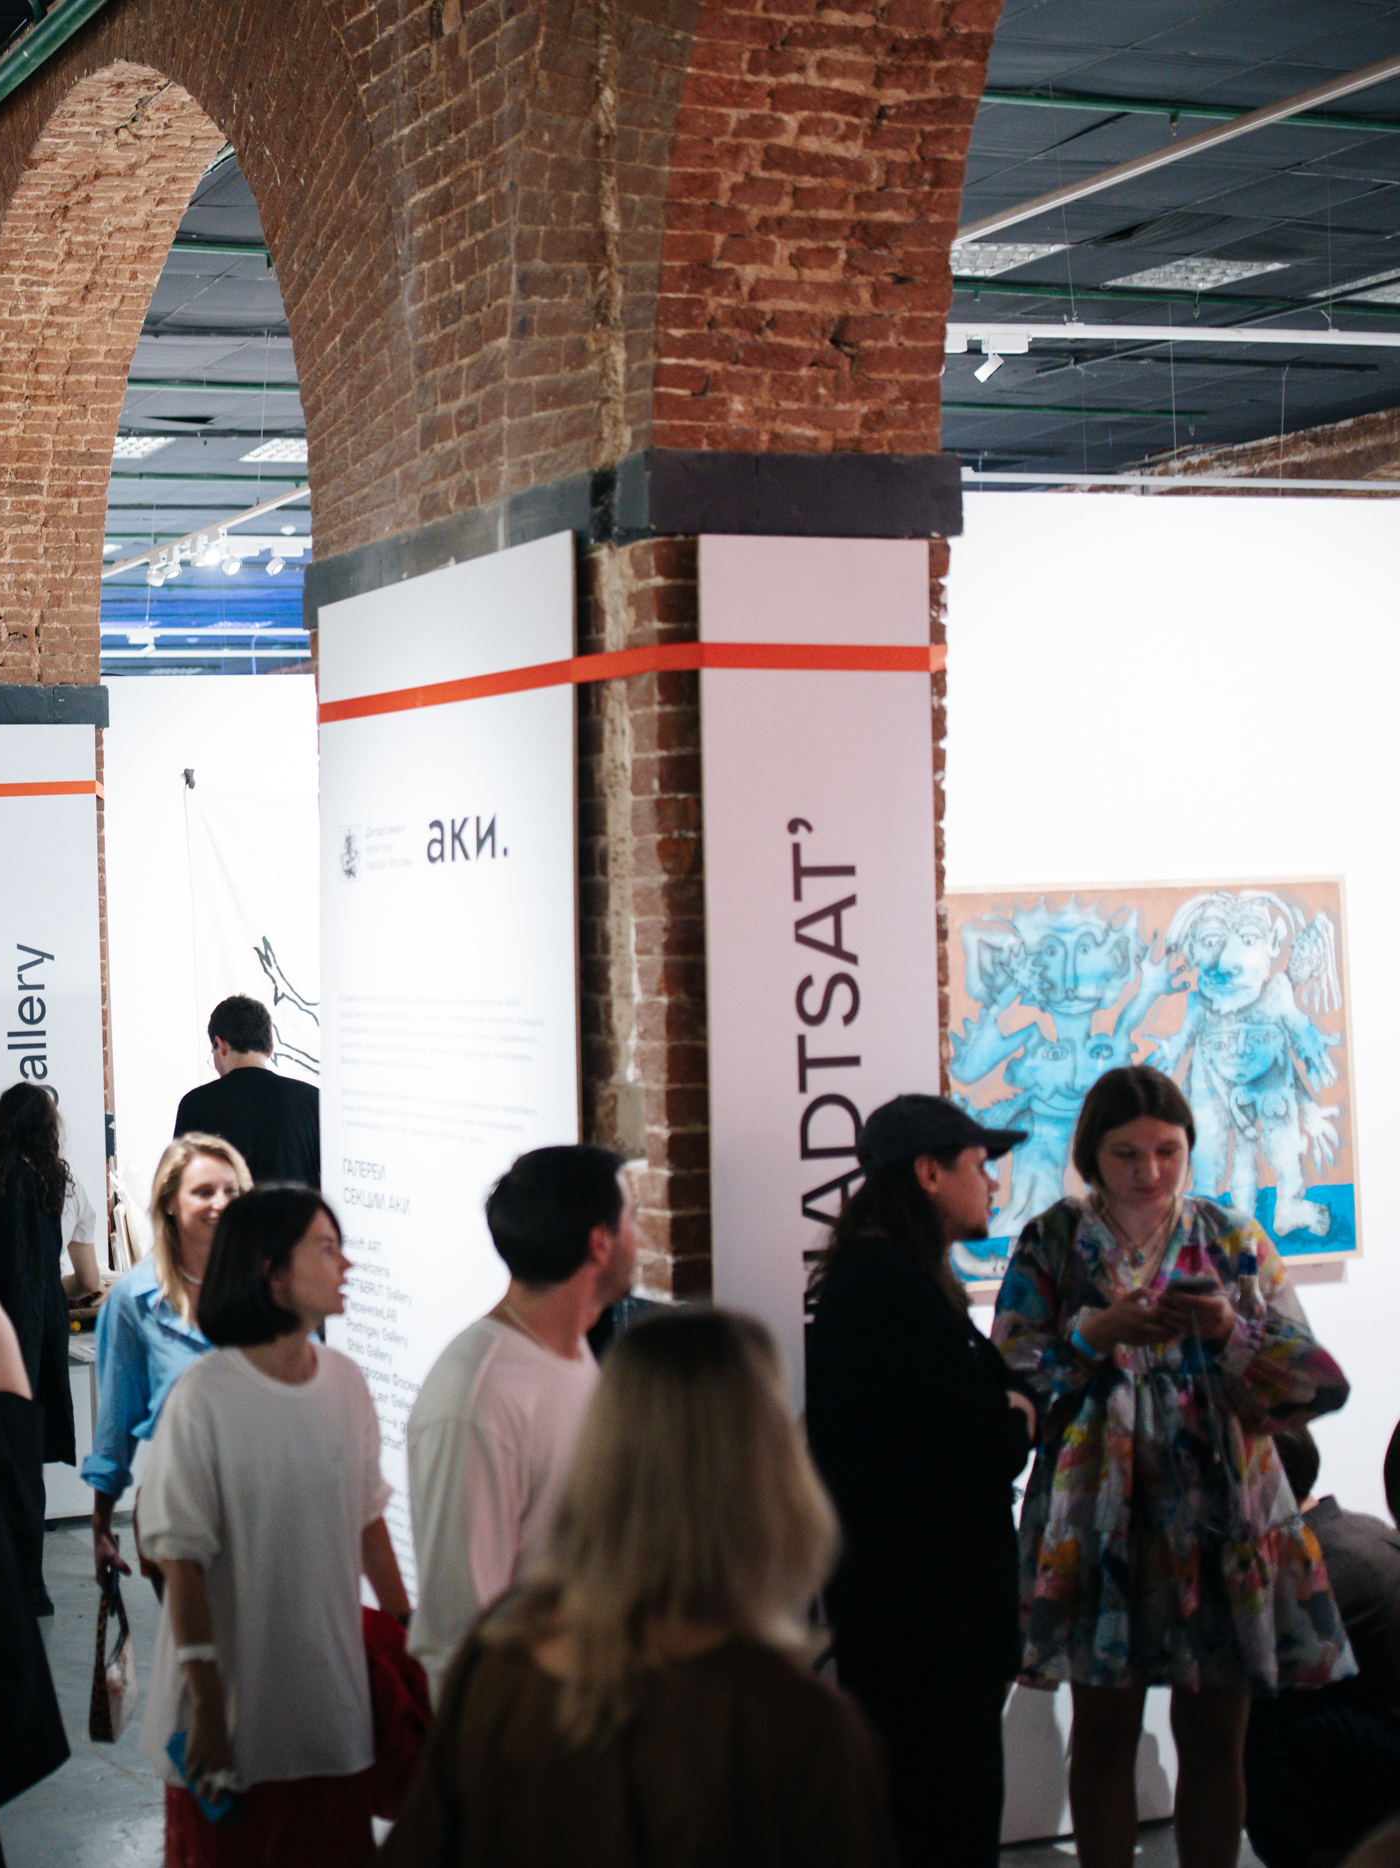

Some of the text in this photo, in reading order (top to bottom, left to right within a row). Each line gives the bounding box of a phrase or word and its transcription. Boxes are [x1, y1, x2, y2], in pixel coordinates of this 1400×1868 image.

[427, 812, 508, 864] аки.
[343, 1158, 386, 1181] ГАЛЕРЕИ
[343, 1187, 411, 1216] СЕКЦИИ АКИ
